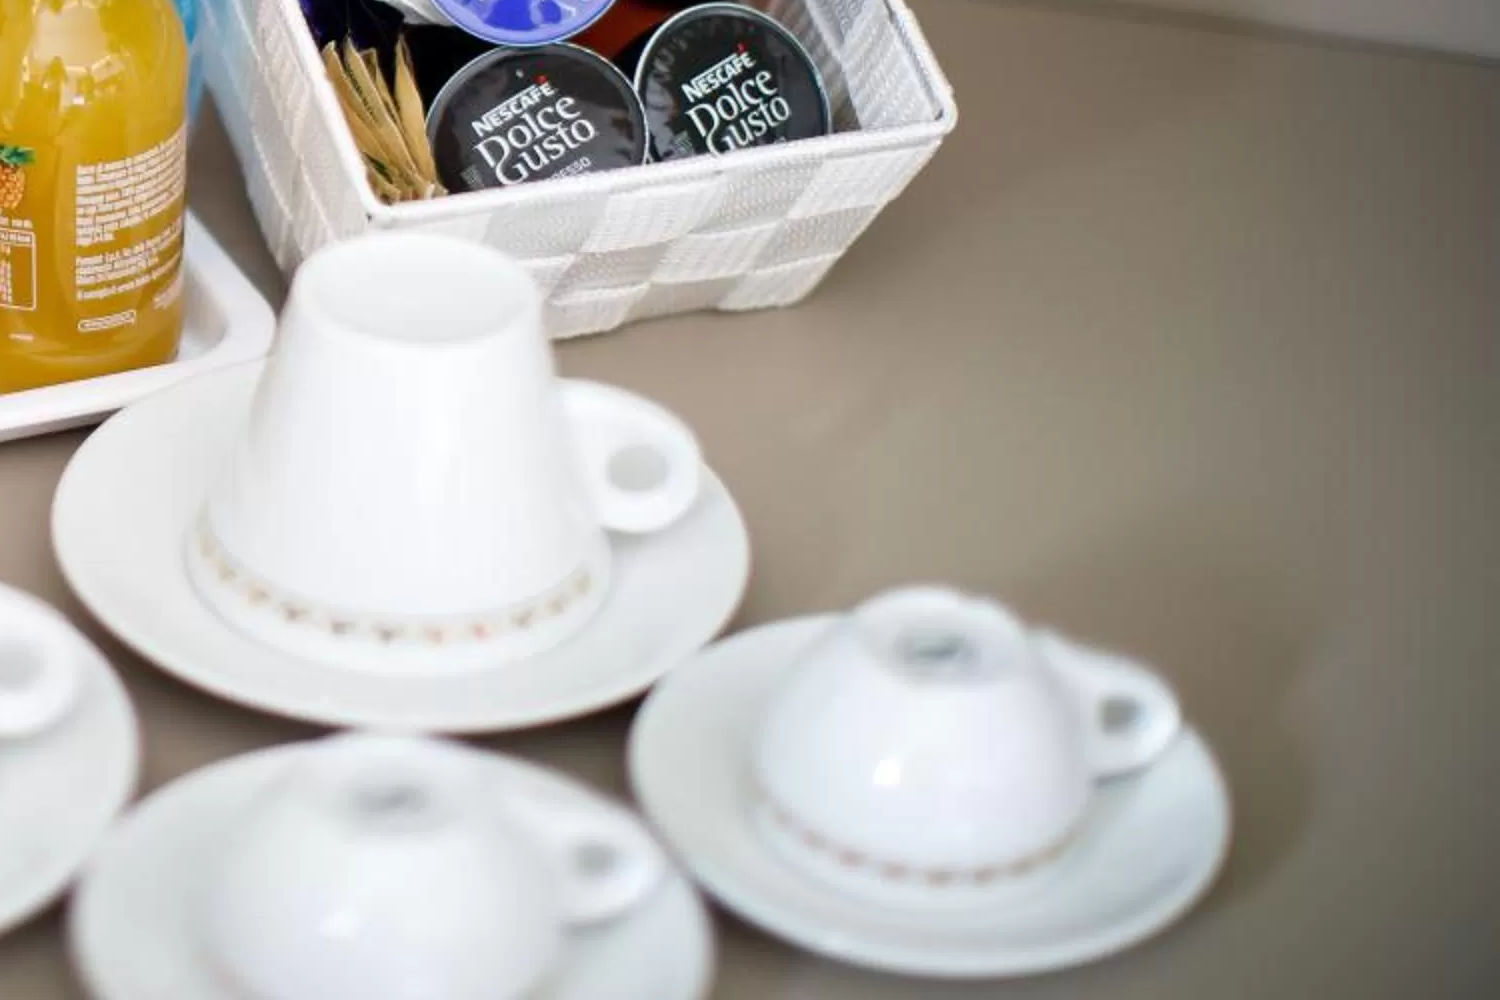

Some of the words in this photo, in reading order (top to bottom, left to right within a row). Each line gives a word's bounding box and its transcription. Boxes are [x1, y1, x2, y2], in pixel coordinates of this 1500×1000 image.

[474, 97, 581, 168] Dolce
[684, 70, 779, 137] Dolce
[706, 97, 791, 156] Gusto
[496, 119, 595, 185] Gusto
